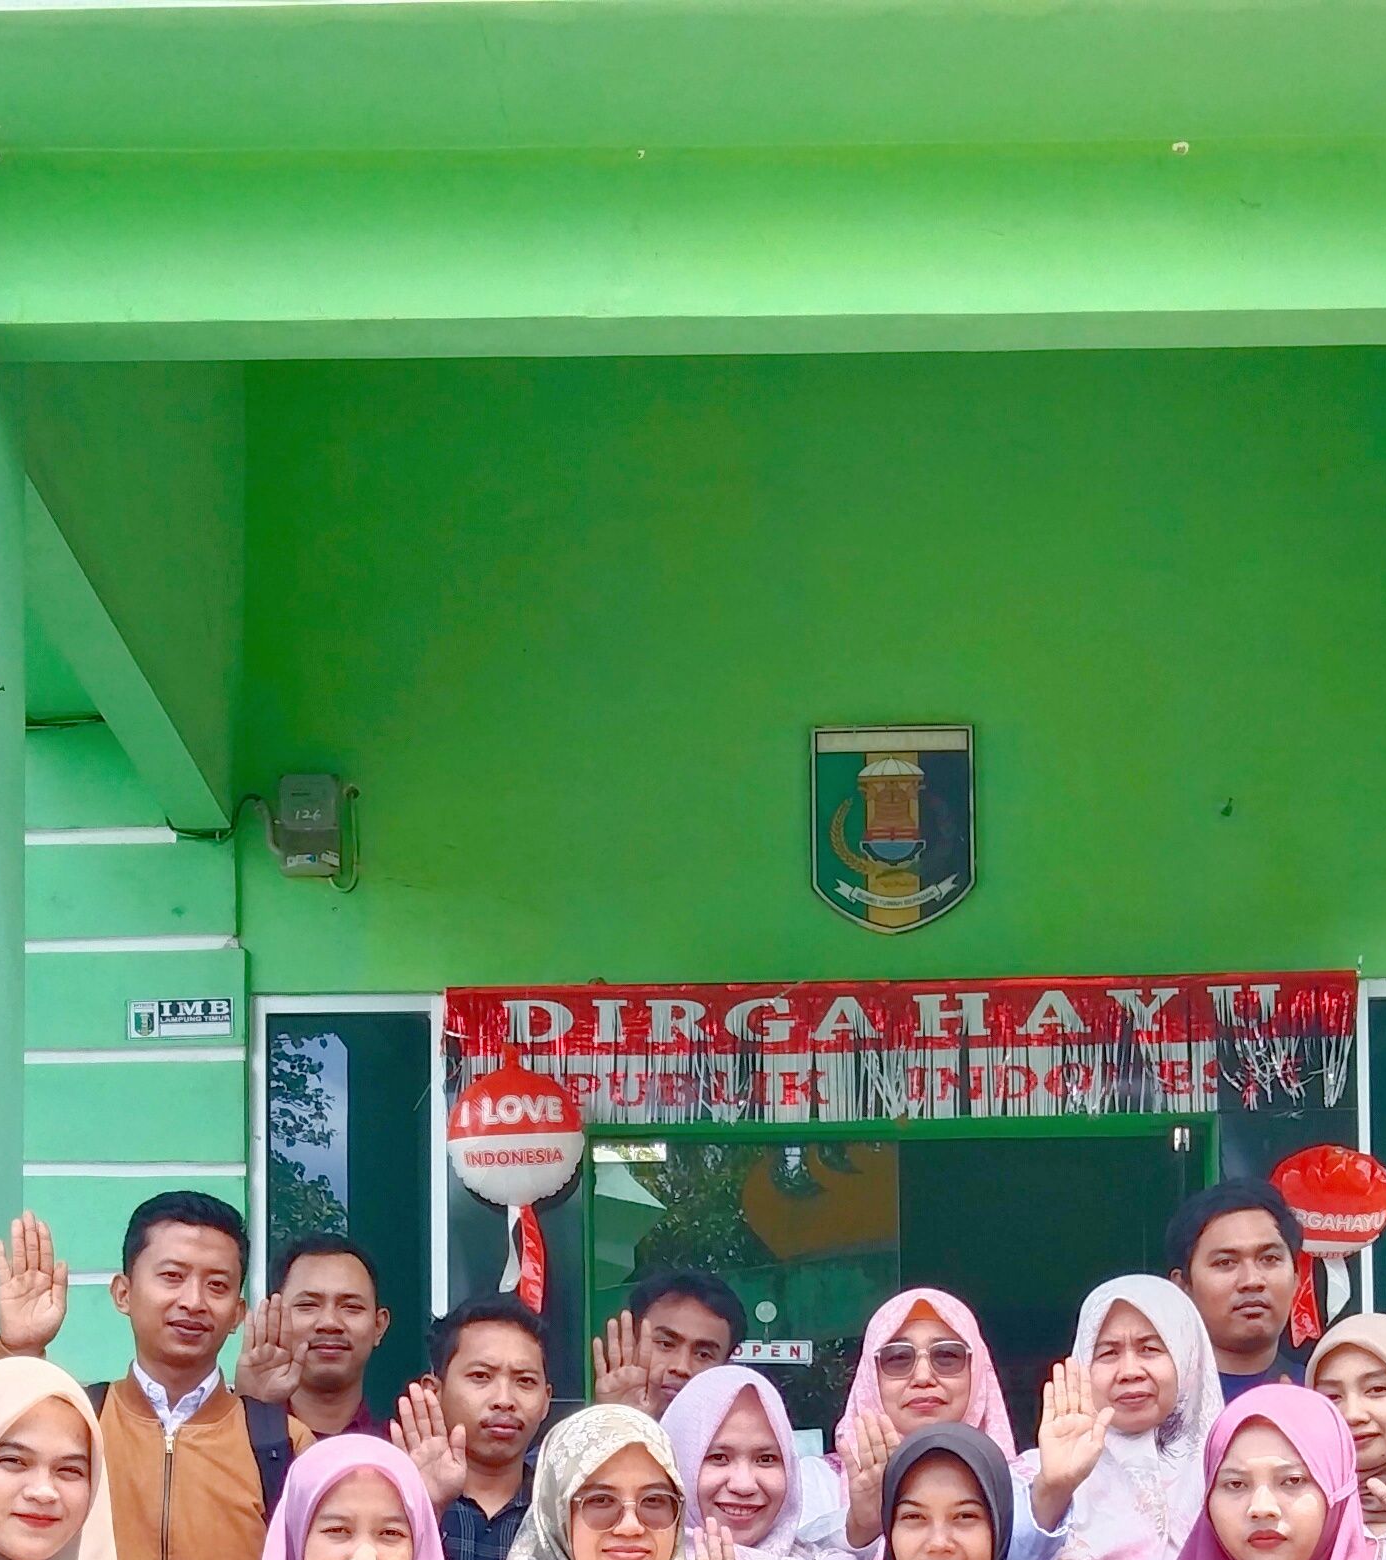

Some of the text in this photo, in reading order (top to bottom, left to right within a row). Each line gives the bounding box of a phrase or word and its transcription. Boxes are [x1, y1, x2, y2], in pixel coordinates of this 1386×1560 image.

[295, 808, 322, 821] 126
[160, 1000, 230, 1016] IMB
[501, 983, 1281, 1043] DIRGAHAYU
[159, 1014, 231, 1023] LAMPUNG TIMUR
[471, 1071, 830, 1107] PUBLIK
[458, 1094, 565, 1128] I LOVE
[465, 1147, 565, 1169] INDONESIA
[731, 1344, 802, 1360] OPEN
